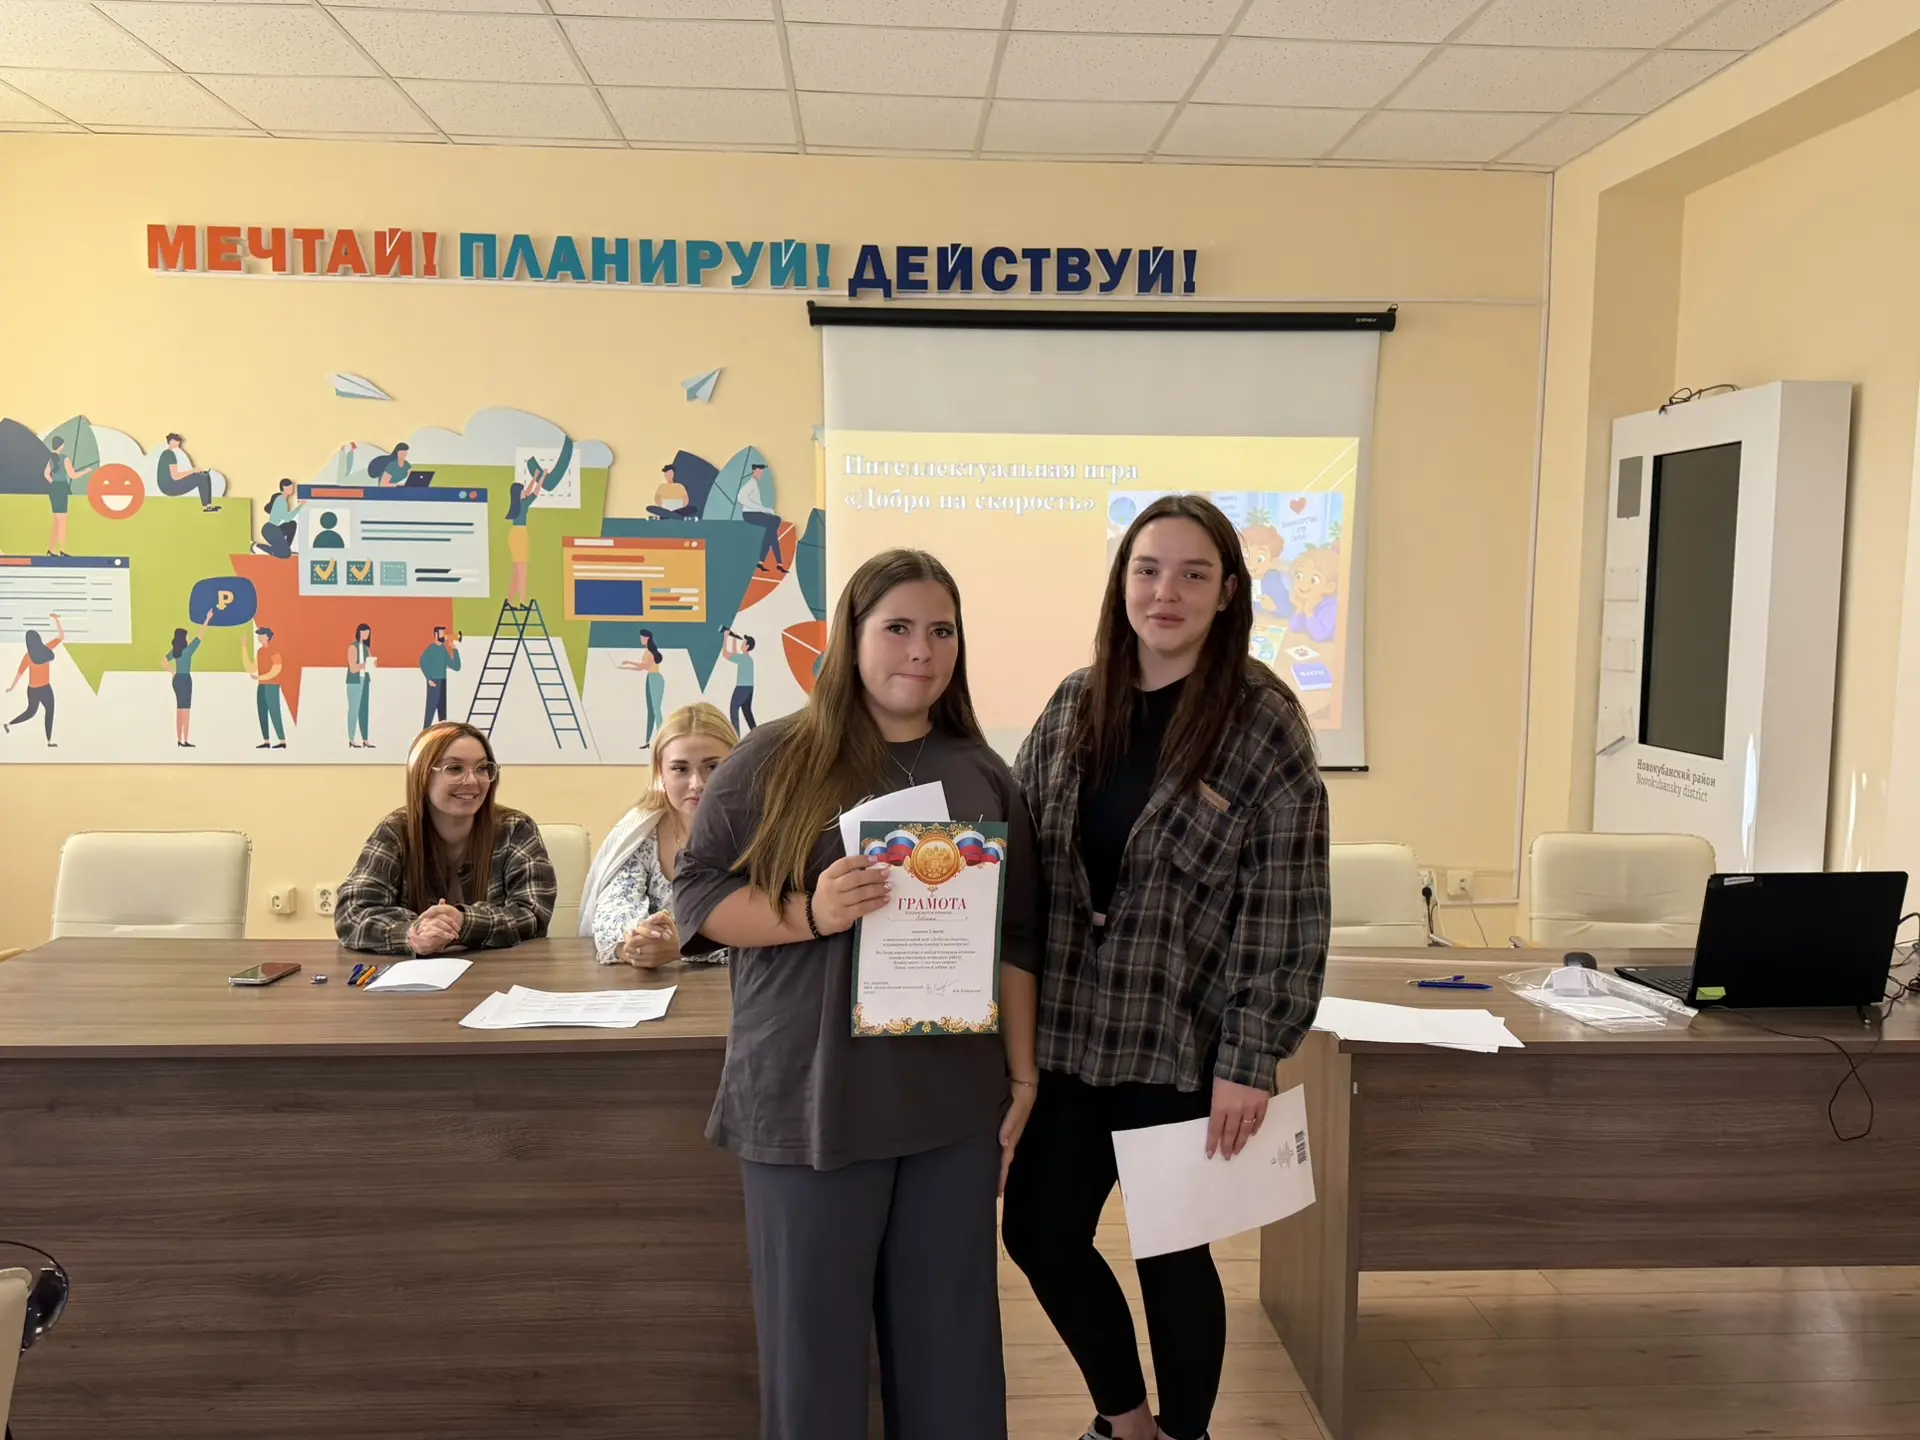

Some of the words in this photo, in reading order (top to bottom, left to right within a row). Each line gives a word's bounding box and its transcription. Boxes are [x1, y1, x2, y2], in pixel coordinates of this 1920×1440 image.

[147, 224, 438, 277] МЕЧТАЙ!
[460, 231, 831, 290] ПЛАНИРУЙ!
[848, 243, 1198, 299] ДЕЙСТВУЙ!
[844, 454, 1076, 482] Интеллектуальная
[1083, 463, 1138, 484] игра
[844, 488, 932, 514] «Добро
[939, 494, 967, 510] на
[975, 495, 1095, 515] скорость»
[1636, 773, 1682, 798] Novokubansky
[1682, 783, 1708, 803] district
[1637, 758, 1691, 782] Новокубанский
[1692, 772, 1716, 788] район
[898, 897, 967, 911] ГРАМОТА
